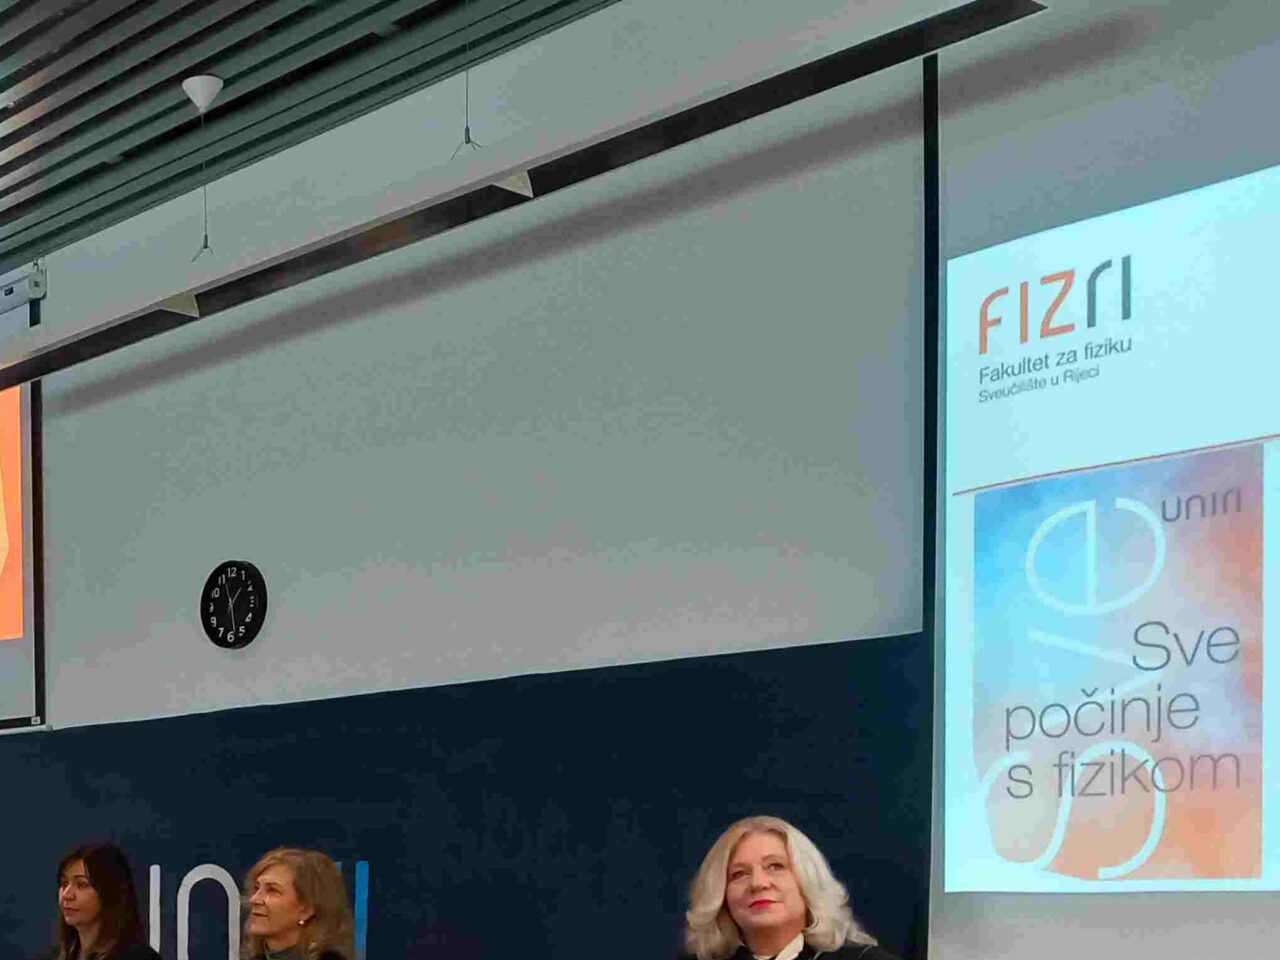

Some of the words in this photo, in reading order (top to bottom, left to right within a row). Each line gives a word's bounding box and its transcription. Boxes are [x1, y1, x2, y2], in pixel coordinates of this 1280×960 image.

[979, 354, 1050, 385] Fakultet
[1055, 349, 1078, 366] za
[1084, 337, 1133, 360] fiziku
[1050, 376, 1060, 386] u
[1063, 364, 1100, 384] Rijeci
[227, 567, 237, 578] 12
[218, 574, 226, 585] 11
[211, 587, 220, 598] 10
[218, 627, 224, 638] 7
[238, 625, 246, 636] 5
[227, 631, 235, 642] 6
[1132, 621, 1240, 671] Sve
[1005, 683, 1200, 751] počinje
[1006, 764, 1034, 799] s
[1053, 748, 1241, 798] fizikom
